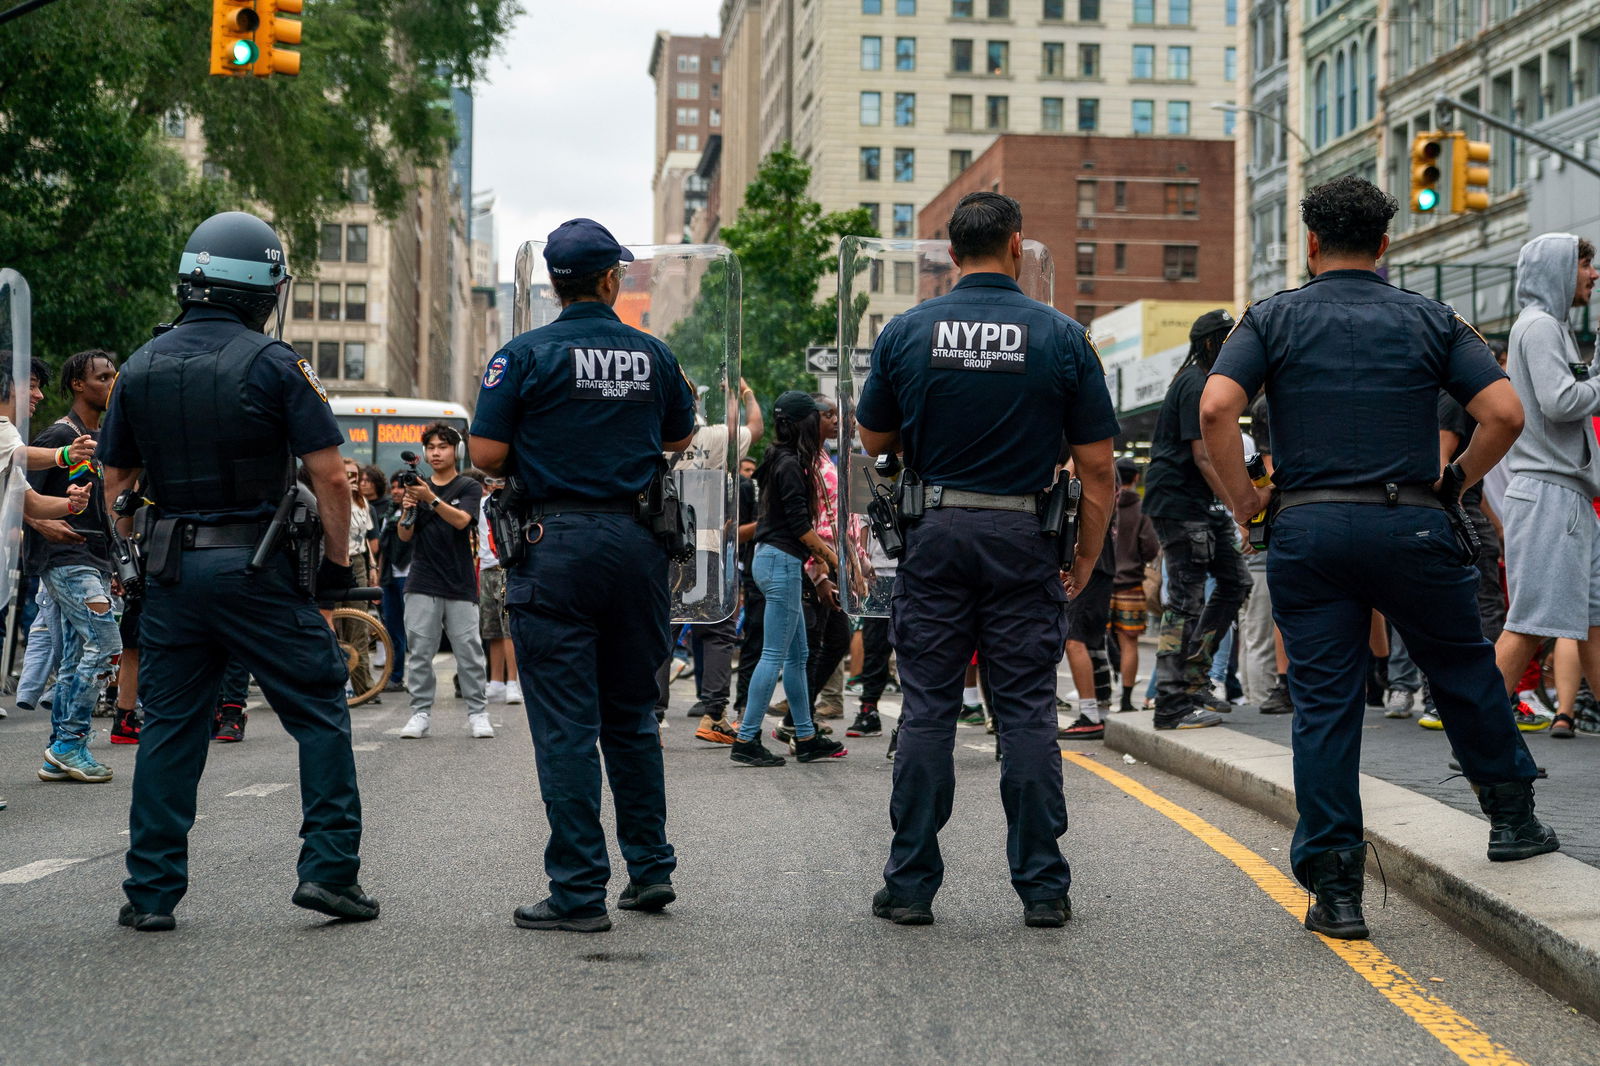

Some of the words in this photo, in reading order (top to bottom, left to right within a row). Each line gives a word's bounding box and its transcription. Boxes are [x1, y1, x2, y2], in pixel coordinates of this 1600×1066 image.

[265, 248, 280, 261] 107
[938, 322, 1021, 351] NYPD
[932, 348, 977, 358] STRATEGIC
[981, 351, 1025, 361] RESPONSE
[574, 349, 650, 381] NYPD
[963, 359, 992, 368] GROUP
[576, 380, 614, 389] STRATEGIC
[616, 382, 650, 391] RESPONSE
[602, 389, 628, 398] GROUP
[349, 428, 368, 442] VIA
